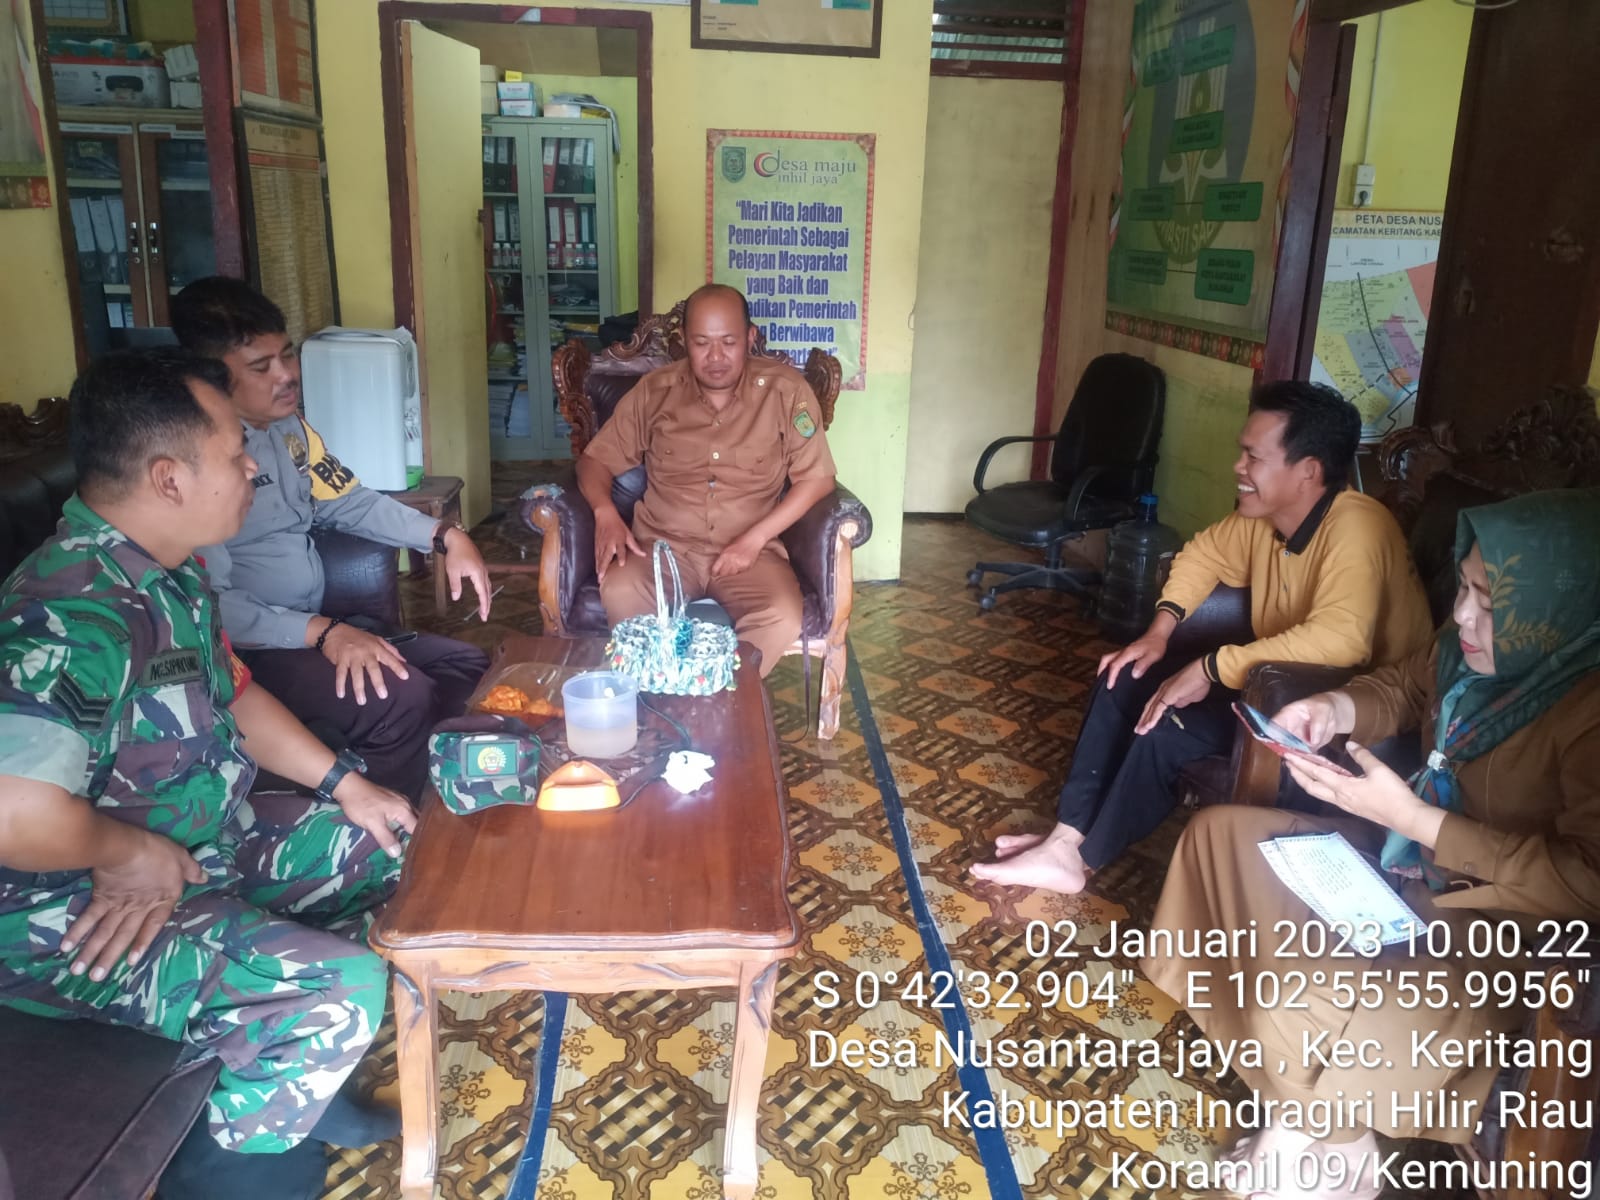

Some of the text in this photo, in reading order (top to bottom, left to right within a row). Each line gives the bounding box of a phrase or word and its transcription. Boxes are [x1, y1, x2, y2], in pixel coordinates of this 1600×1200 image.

[754, 148, 856, 177] desa maju
[778, 172, 838, 187] inhil jaya
[771, 201, 794, 221] Kita
[797, 201, 842, 223] Jadikan
[1356, 214, 1384, 225] PETA
[1387, 215, 1417, 225] DESA
[728, 224, 849, 249] Pemerintah Sebagai
[1332, 227, 1376, 235] CAMATAN
[1379, 228, 1422, 236] KERITANG
[728, 248, 848, 273] Pelayan Masyarakat
[747, 275, 829, 296] yang Baik dan
[748, 299, 857, 319] adikan Pemerintah
[770, 322, 834, 342] Berwibawa
